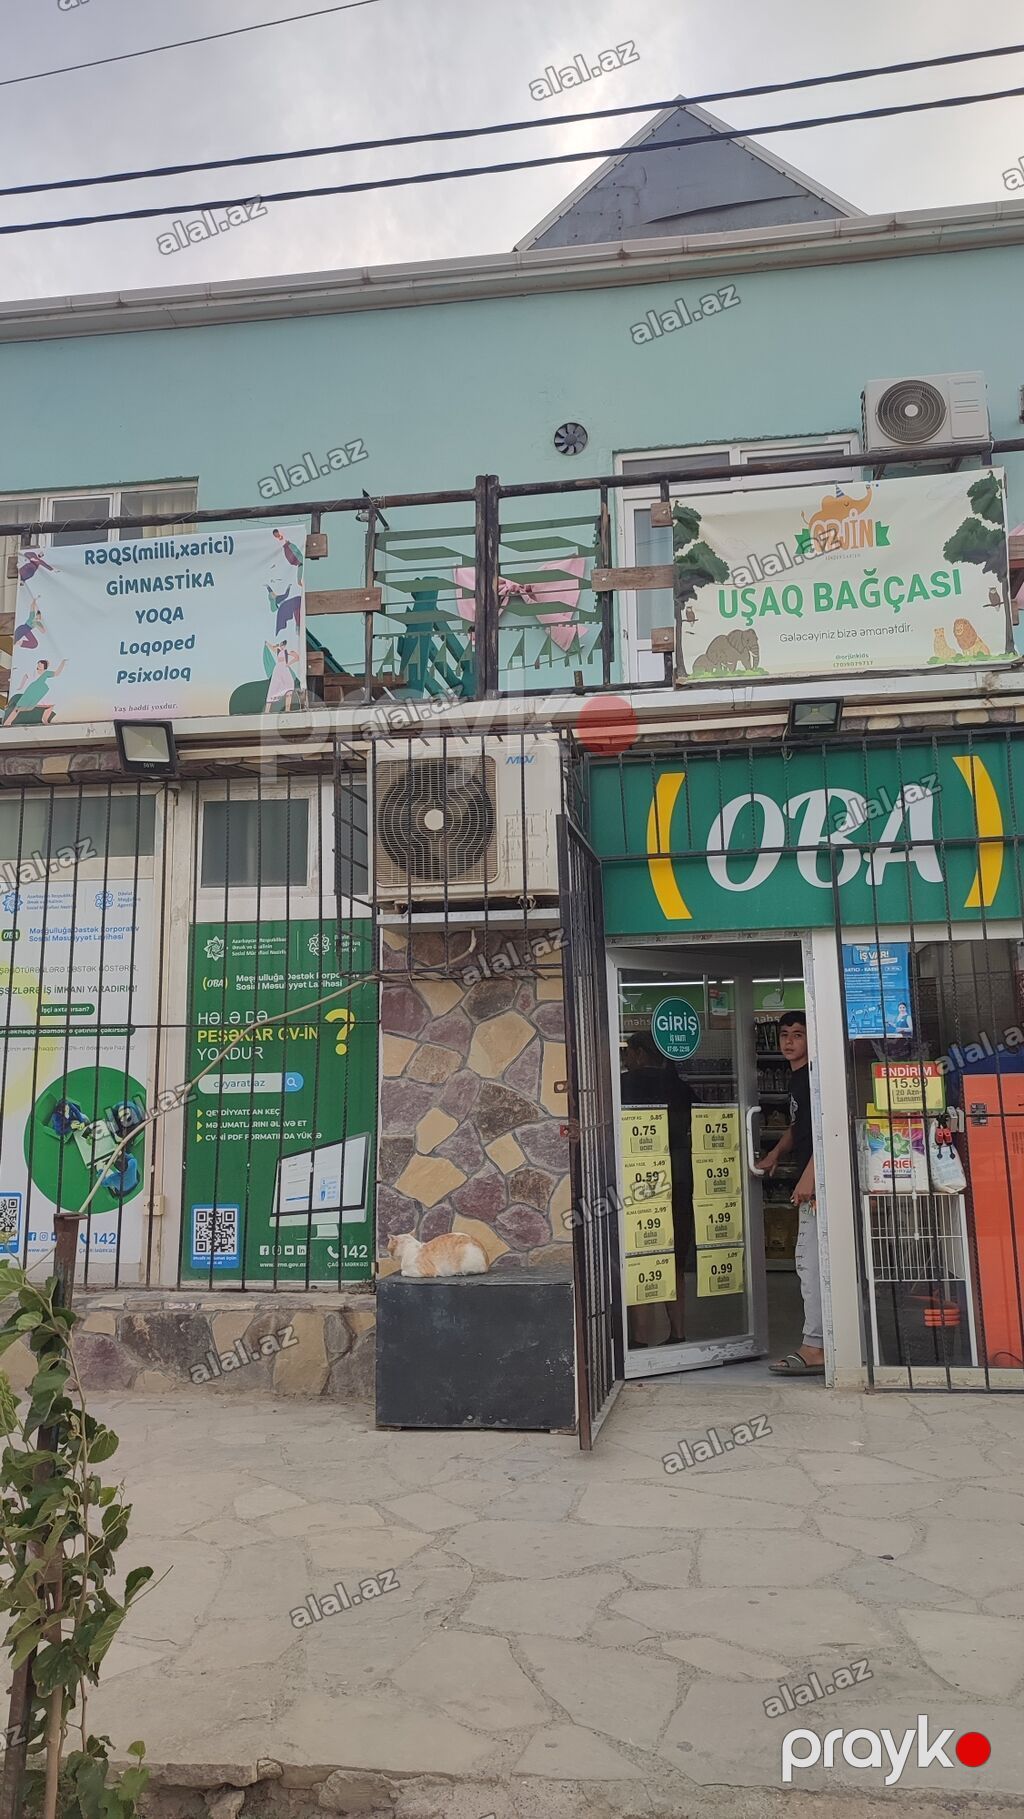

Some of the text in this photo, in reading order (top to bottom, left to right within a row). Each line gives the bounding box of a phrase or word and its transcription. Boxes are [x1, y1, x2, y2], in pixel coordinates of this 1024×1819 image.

[84, 535, 235, 567] RƏQS(milli,xarici)
[106, 568, 215, 596] GİMNASTİKA
[717, 567, 963, 627] UŞAQ BAĞÇASI
[135, 606, 185, 625] YOQA
[779, 622, 914, 643] Gələcəyiniz bizə əmanətdir.
[119, 634, 196, 657] Loqoped
[116, 664, 192, 685] Psixoloq
[262, 981, 307, 991] Məsuyyət
[308, 979, 343, 988] Laihəsi
[656, 1011, 698, 1036] GİRİŞ
[881, 1065, 932, 1077] ENDİRİM
[213, 1079, 266, 1090] cyarataz
[892, 1077, 929, 1089] 15.99
[205, 1108, 264, 1118] QEDİYYATDAN
[205, 1120, 269, 1129] MƏUMATLRINI
[632, 1124, 657, 1137] 0.75
[705, 1123, 728, 1134] 0.75
[227, 1133, 244, 1141] PDF
[296, 1131, 322, 1140] YÜKƏ
[882, 1159, 913, 1169] ARIEL
[706, 1167, 730, 1179] 0.39
[636, 1217, 661, 1231] 1.99
[708, 1212, 731, 1224] 1.99
[93, 1232, 117, 1245] 142
[342, 1244, 368, 1259] 142
[711, 1263, 733, 1276] 0.99
[638, 1270, 663, 1283] 0.39
